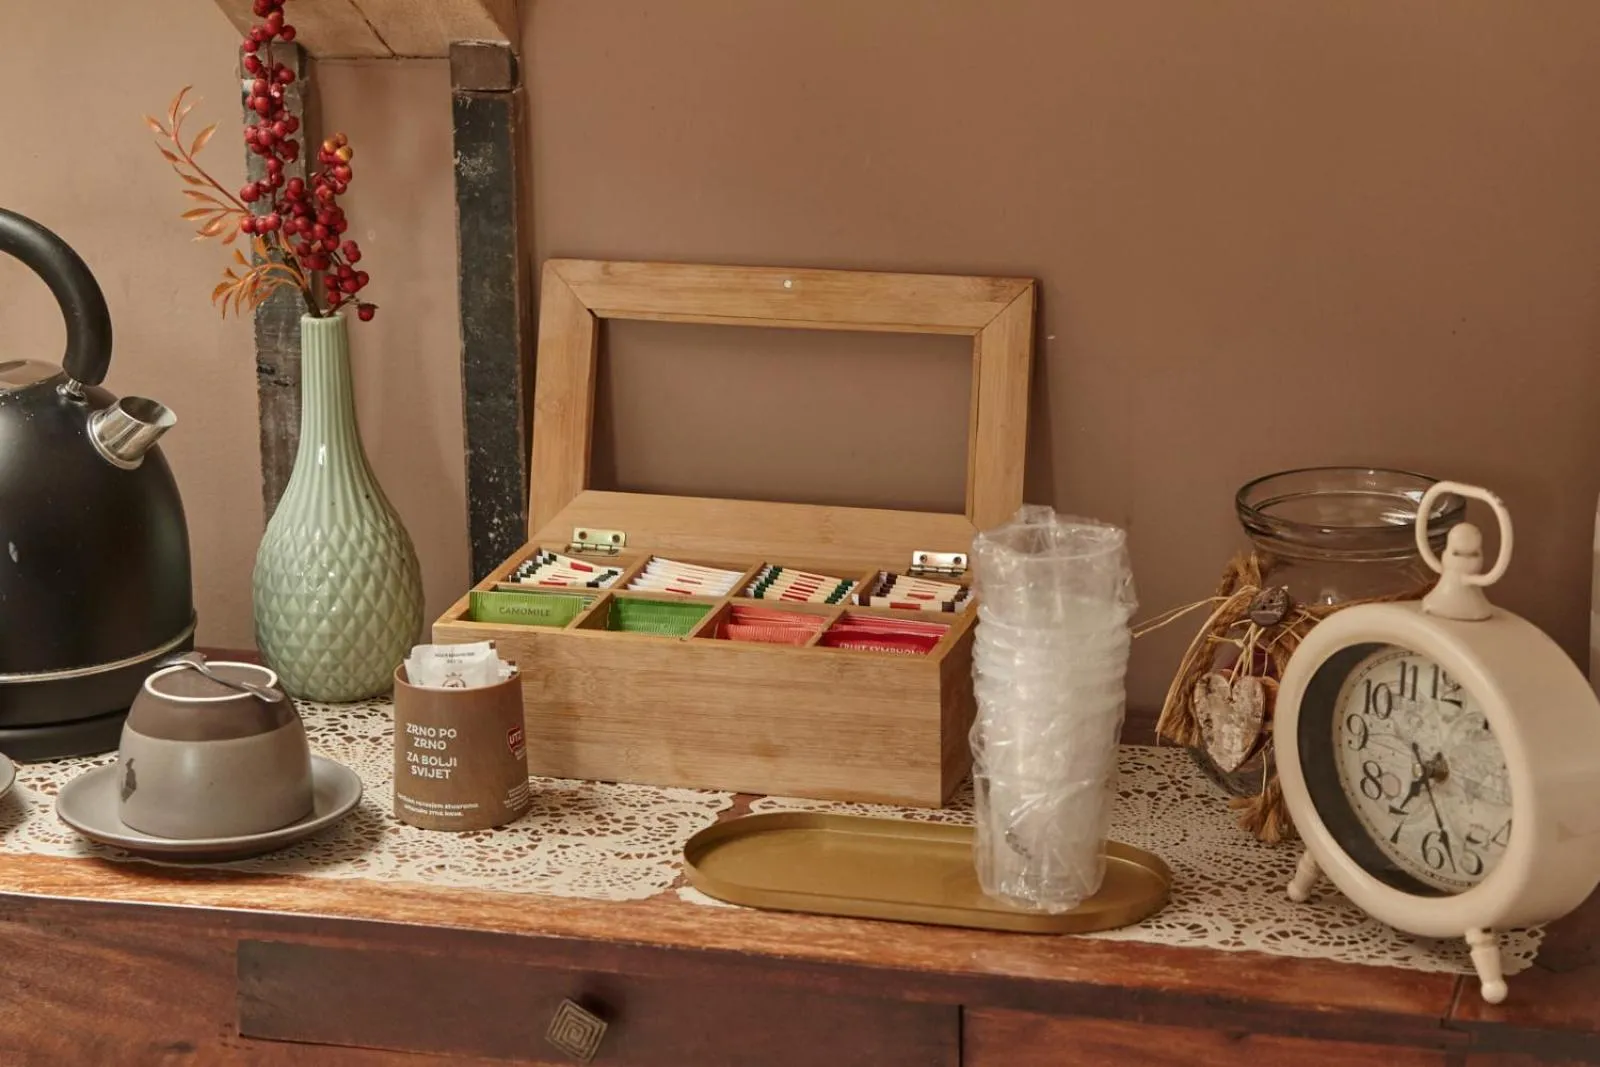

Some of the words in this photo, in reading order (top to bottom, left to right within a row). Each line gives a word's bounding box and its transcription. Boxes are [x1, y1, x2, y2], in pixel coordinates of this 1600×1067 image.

[499, 606, 550, 617] CAMOMILE
[1399, 660, 1419, 701] 11
[1363, 678, 1393, 720] 10
[405, 722, 436, 738] ZRNO
[439, 727, 457, 739] PO
[413, 736, 447, 750] ZRNO
[1346, 713, 1369, 751] 9
[406, 751, 419, 763] ZA
[421, 754, 457, 768] BOLJI
[410, 765, 452, 779] SVIJET
[1360, 760, 1382, 800] 8
[1421, 831, 1445, 871] 6
